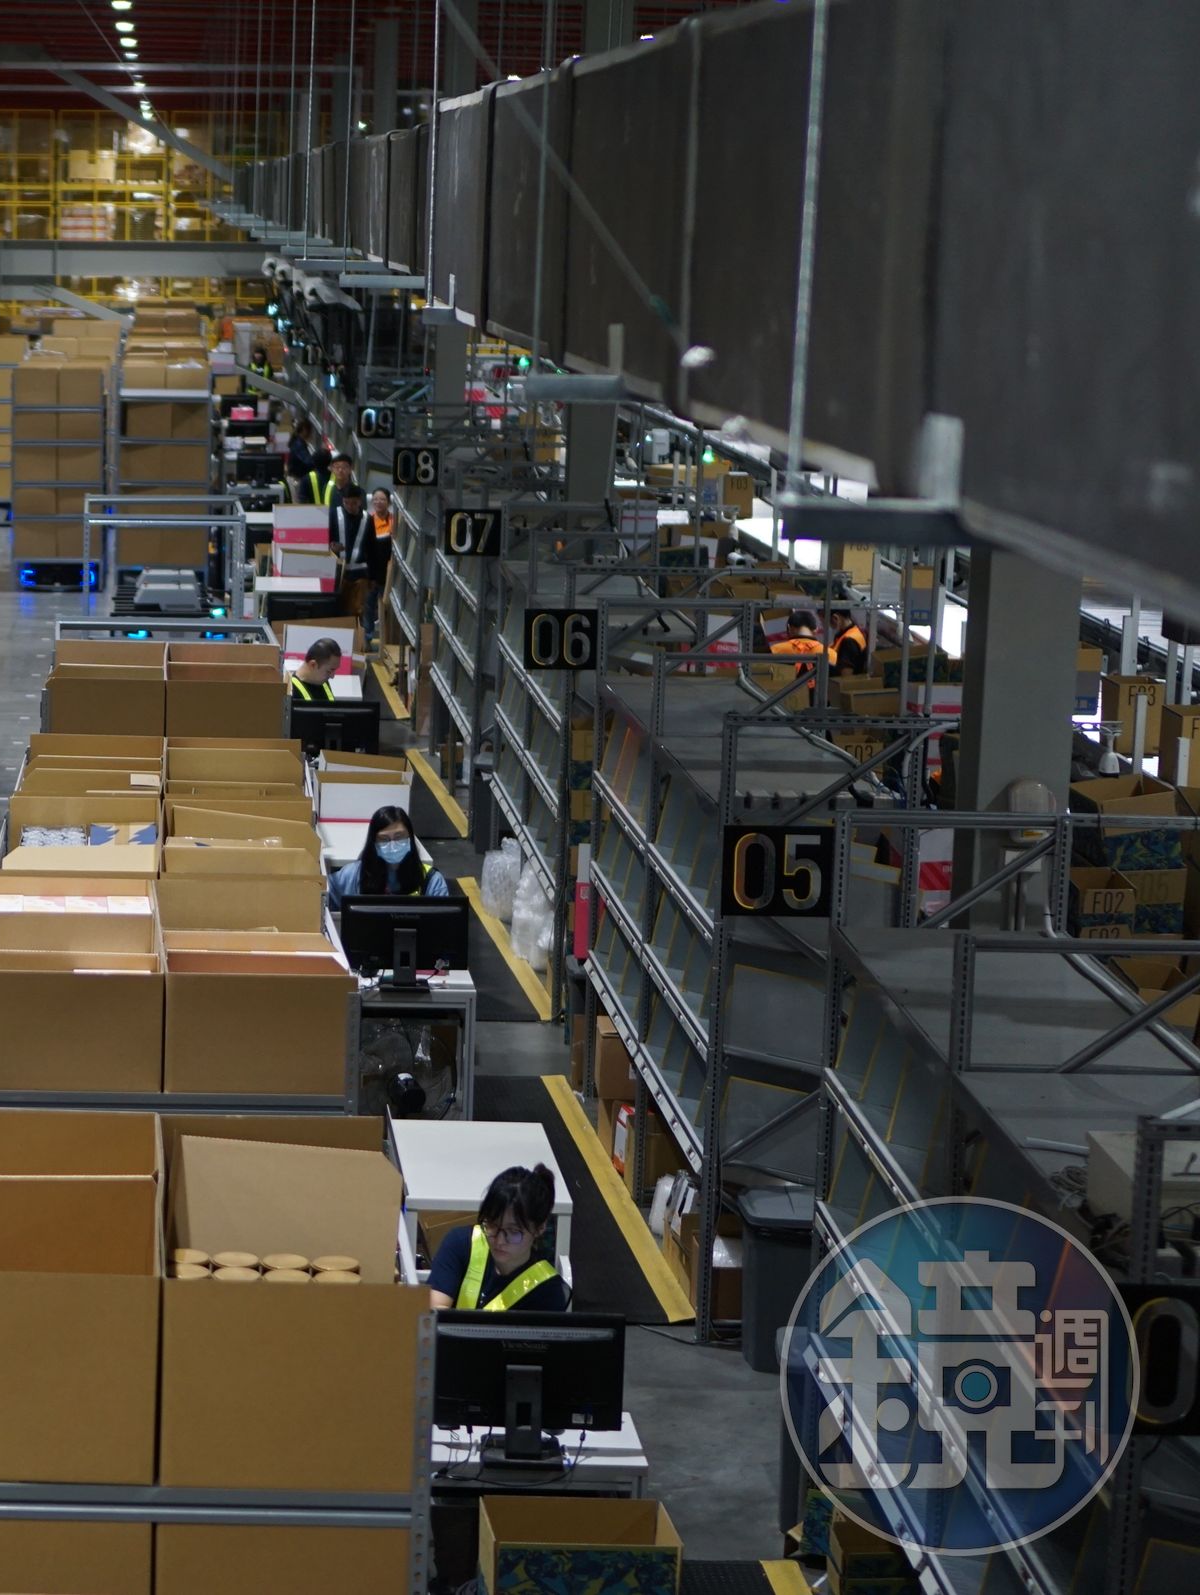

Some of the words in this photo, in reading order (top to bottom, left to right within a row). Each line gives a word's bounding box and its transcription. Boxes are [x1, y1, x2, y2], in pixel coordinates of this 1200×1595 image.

[361, 407, 393, 437] 09
[397, 449, 435, 484] 08
[449, 511, 493, 553] 07
[531, 613, 591, 666] 06
[733, 832, 822, 911] 05
[1093, 891, 1125, 914] F02
